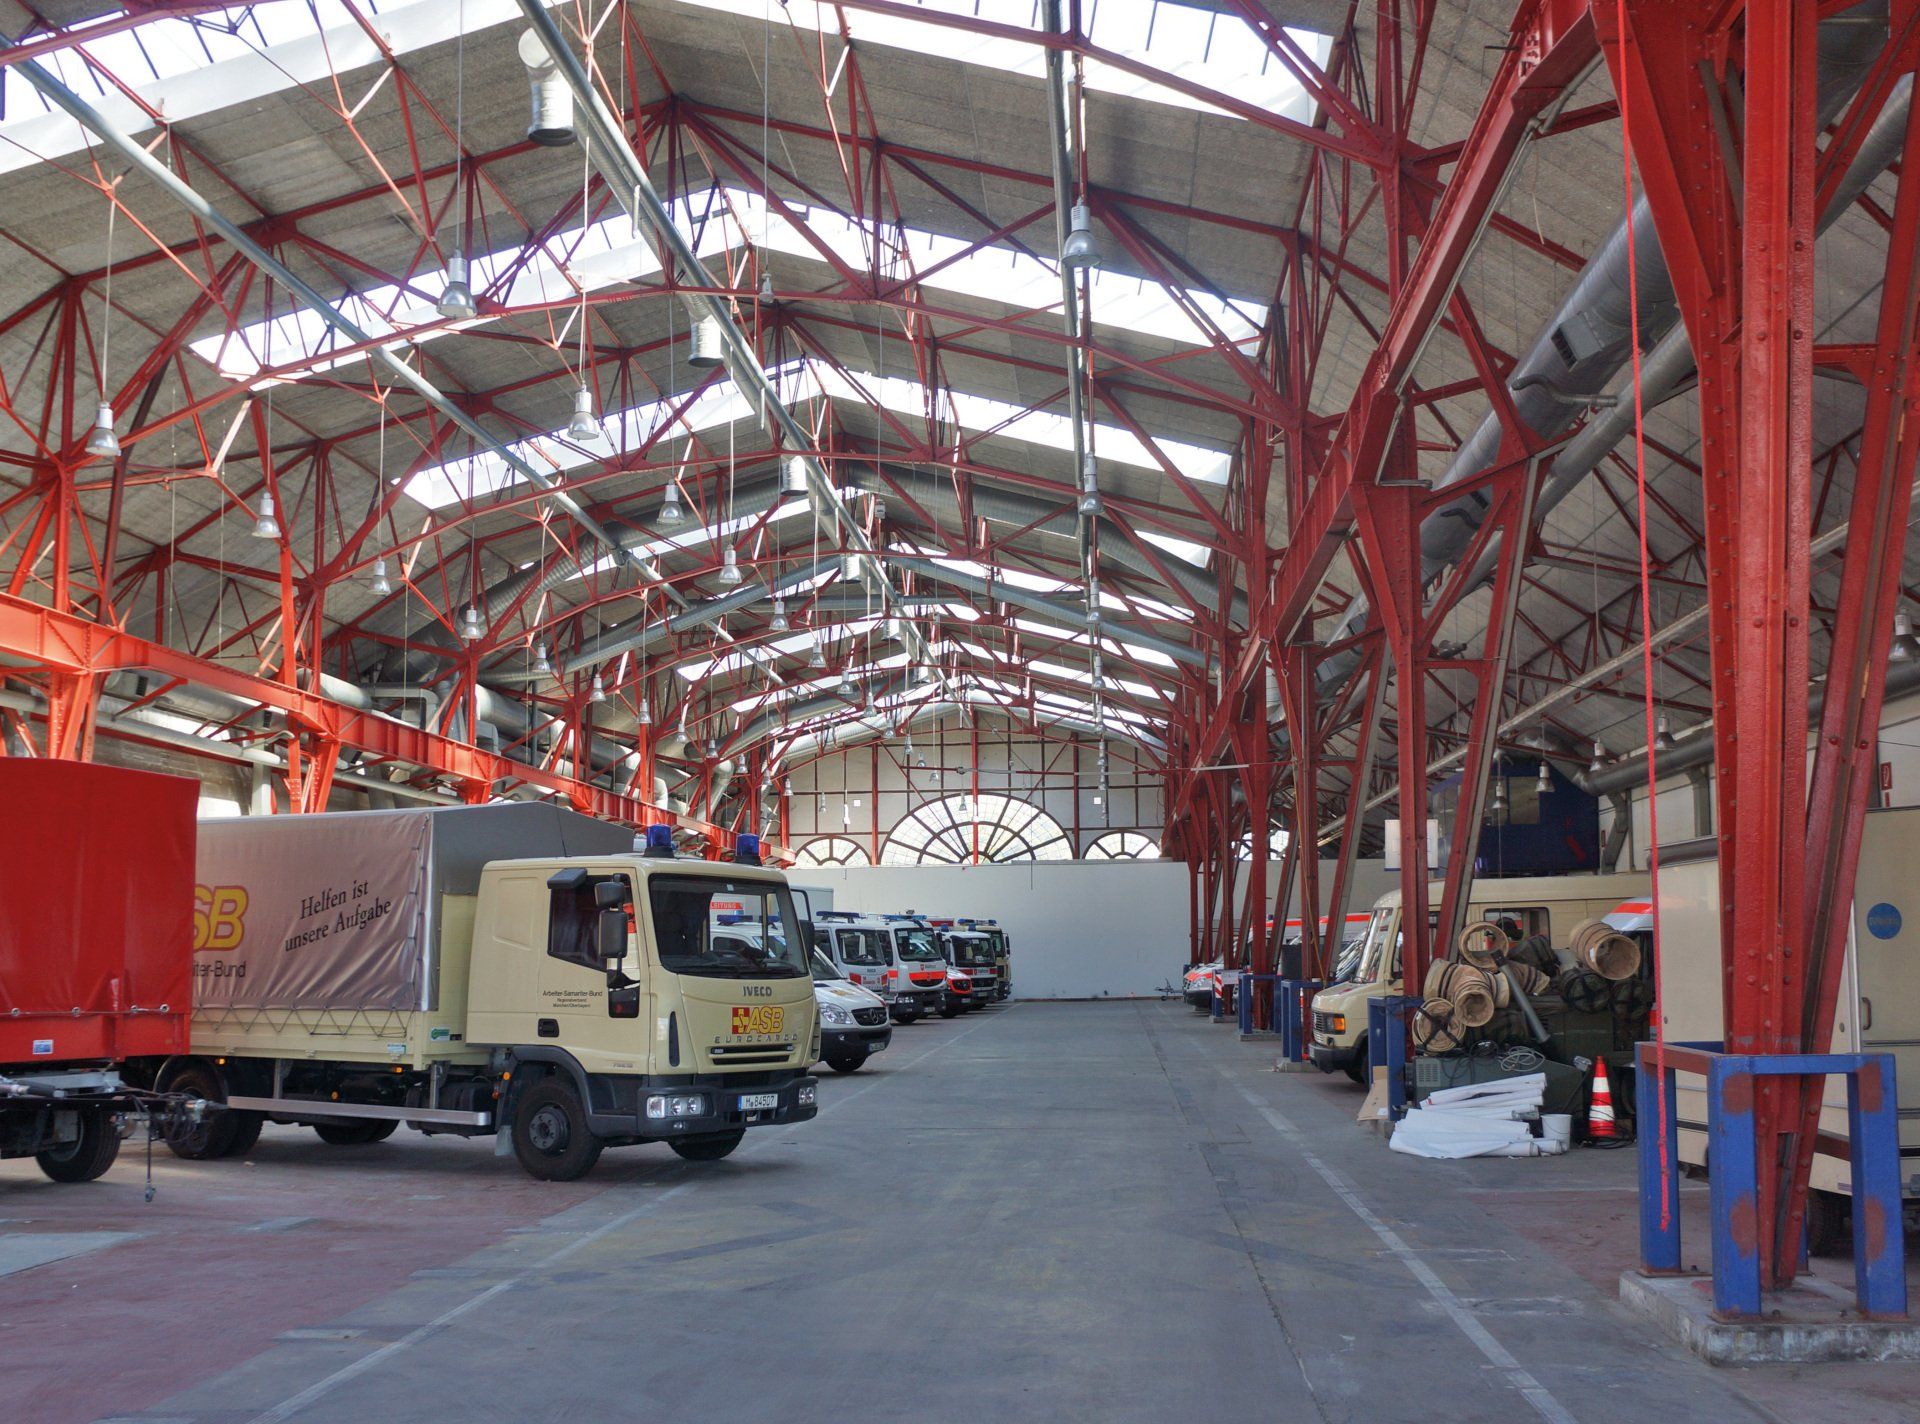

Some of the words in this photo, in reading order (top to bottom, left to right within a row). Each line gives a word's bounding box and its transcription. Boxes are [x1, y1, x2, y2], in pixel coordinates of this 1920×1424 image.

[300, 887, 347, 920] Helfen
[351, 880, 369, 900] ist
[285, 925, 329, 952] unsere
[334, 898, 392, 934] Aufgabe
[743, 986, 773, 997] IVECO
[746, 1006, 784, 1034] ASB
[714, 1033, 799, 1044] EUROCARGO
